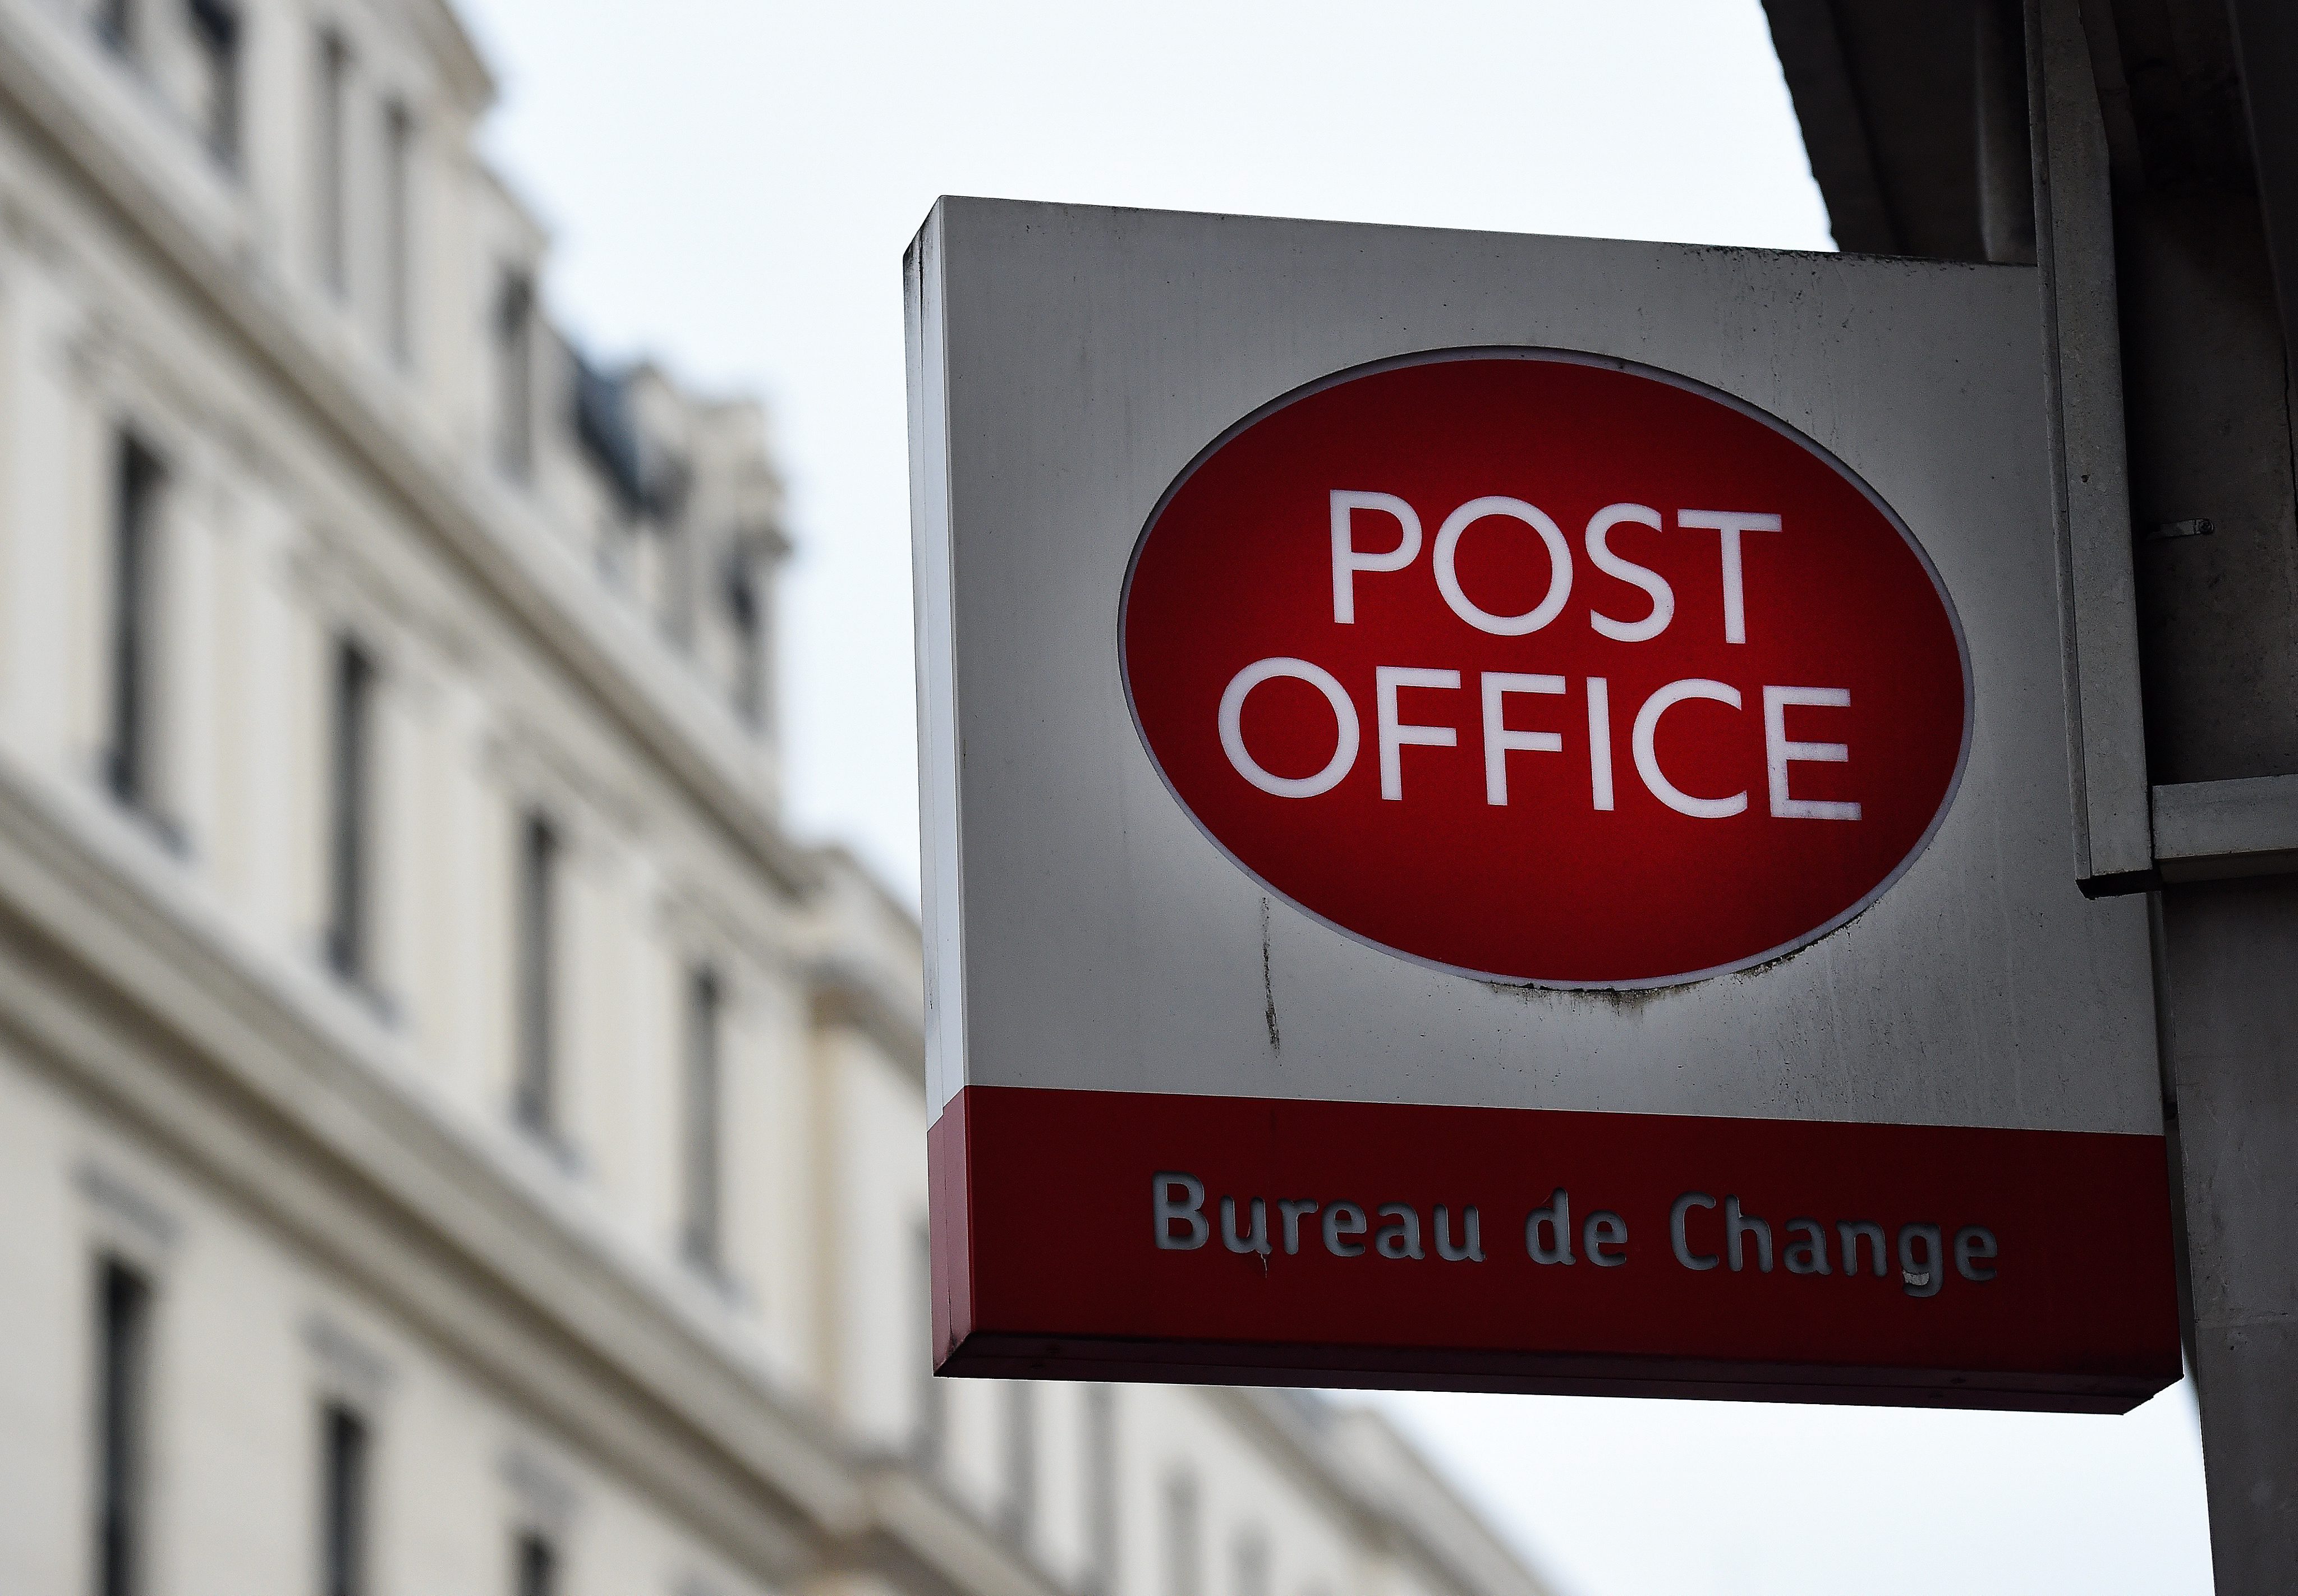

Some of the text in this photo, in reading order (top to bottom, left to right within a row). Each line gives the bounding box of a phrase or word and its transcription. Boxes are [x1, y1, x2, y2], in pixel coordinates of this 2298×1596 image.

[1330, 489, 1782, 646] POST
[1217, 656, 1862, 822] OFFICE
[1152, 1171, 2000, 1298] Bureau de Change
